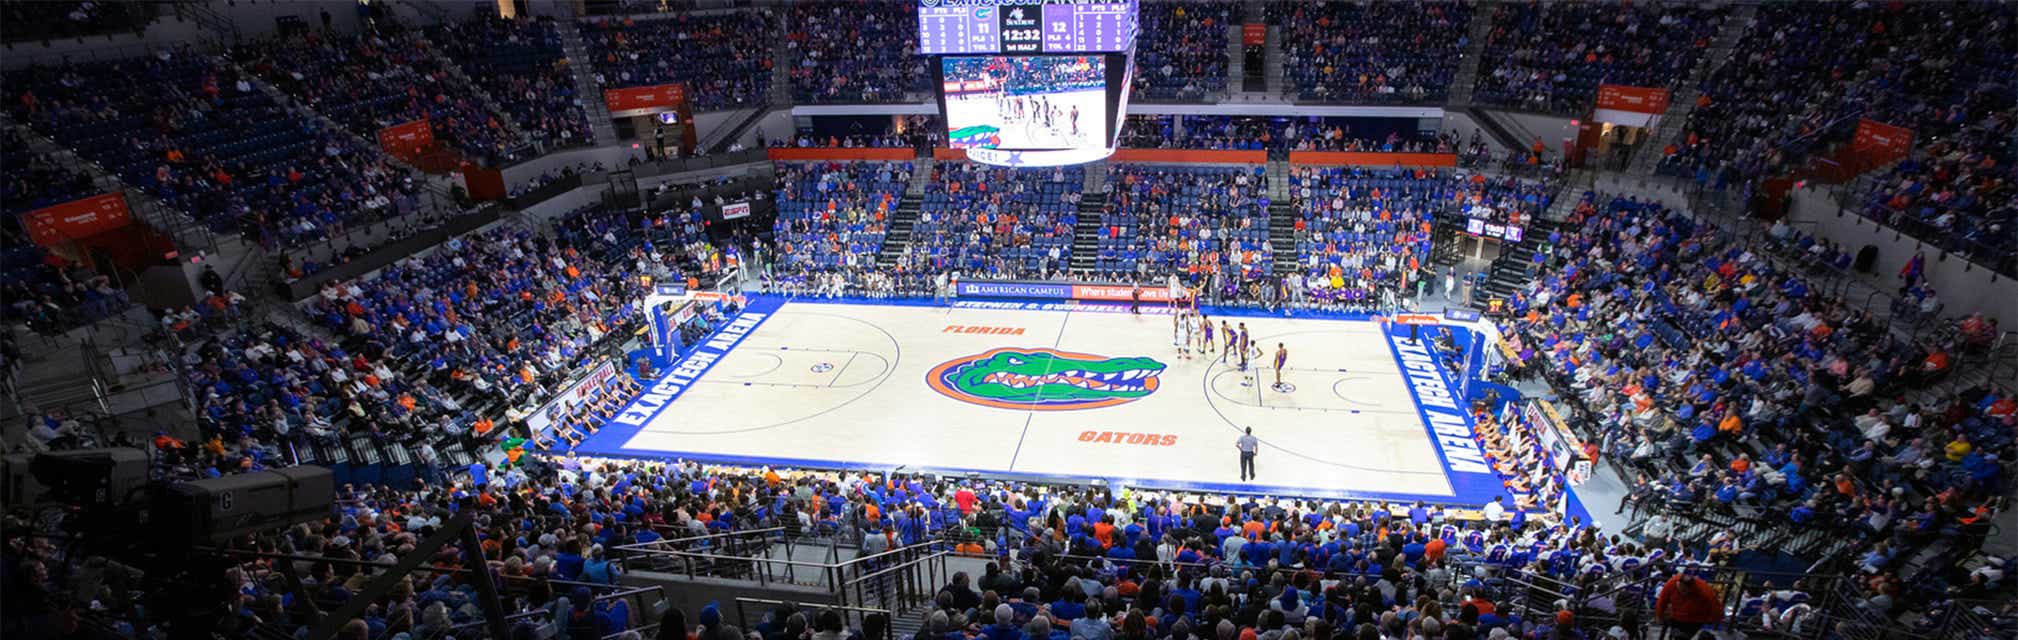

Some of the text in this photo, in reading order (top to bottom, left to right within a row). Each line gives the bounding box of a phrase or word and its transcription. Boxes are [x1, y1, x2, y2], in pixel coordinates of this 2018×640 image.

[978, 23, 989, 34] 11
[1052, 21, 1067, 33] 12
[1002, 29, 1041, 41] 12:32
[980, 286, 1065, 296] AMERICAN CAMPUS
[1080, 286, 1105, 297] Where
[942, 325, 1026, 336] FLORIDA
[613, 312, 768, 426] EXACTECH ARENA
[1391, 335, 1492, 474] EXACTECH ARENA
[1077, 430, 1179, 447] GATORS
[221, 491, 232, 510] G
